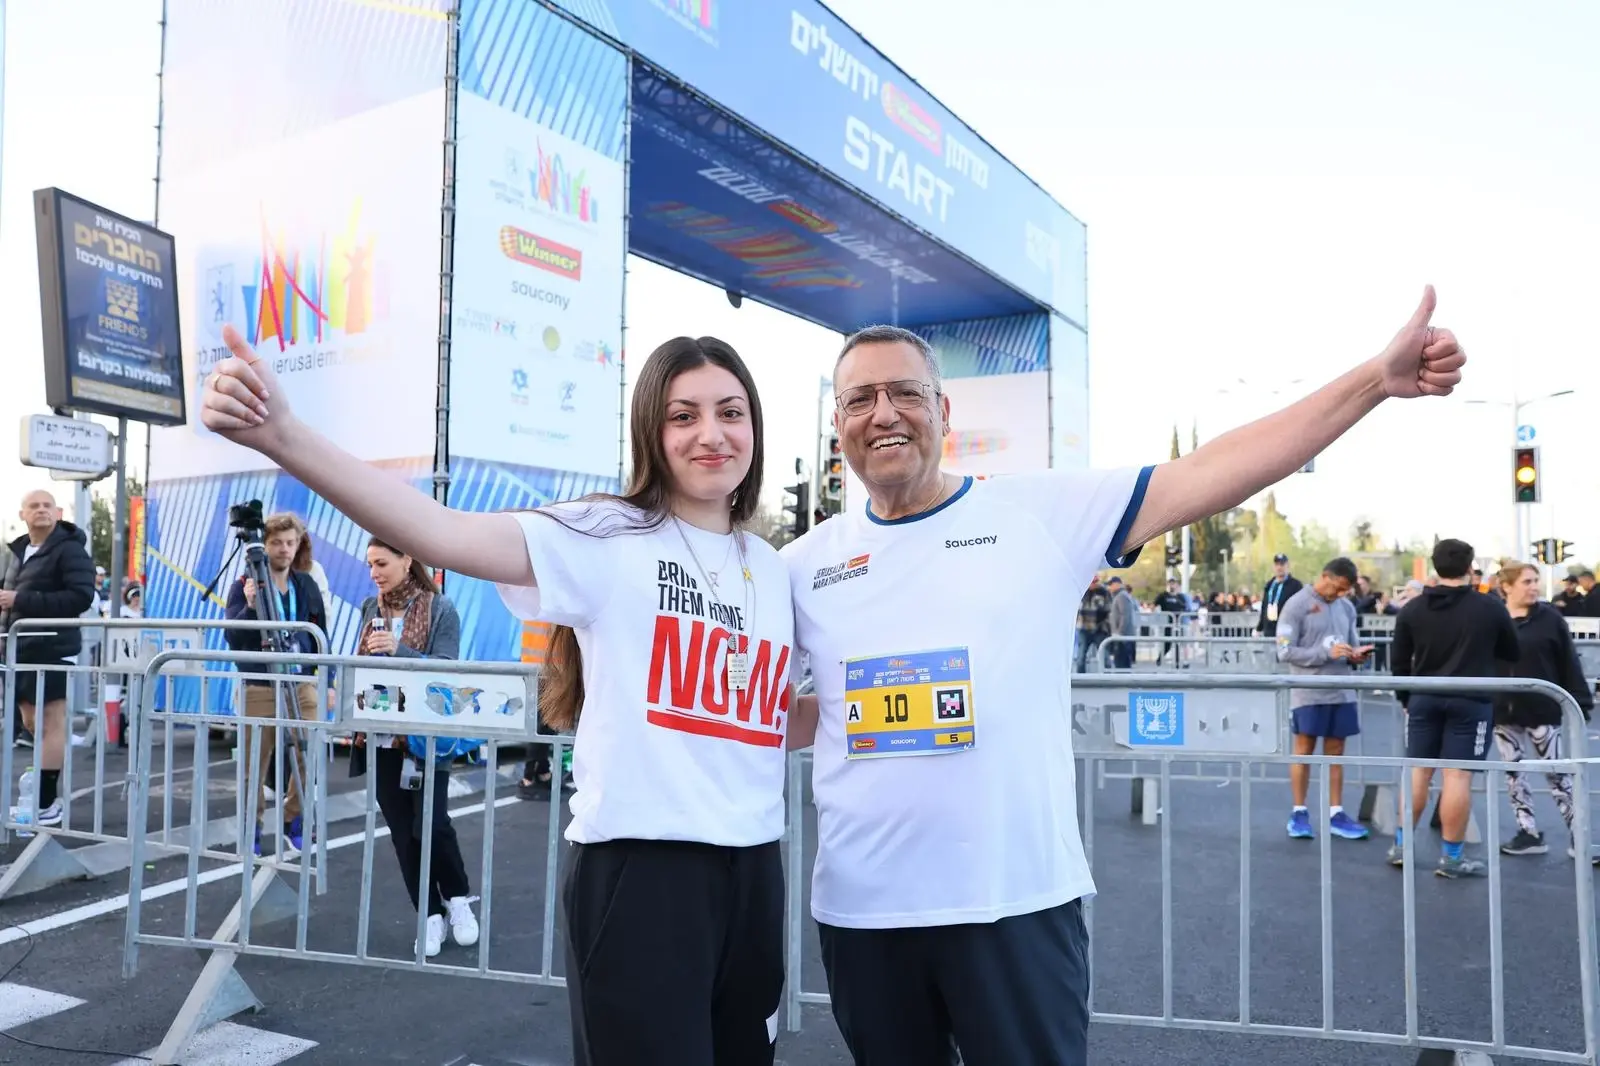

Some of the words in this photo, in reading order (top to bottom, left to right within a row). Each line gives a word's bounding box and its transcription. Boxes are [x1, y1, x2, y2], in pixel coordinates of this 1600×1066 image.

[791, 9, 879, 101] ירושלים
[844, 115, 955, 224] START
[944, 133, 989, 190] מרתון
[74, 221, 161, 273] החברים
[517, 233, 580, 273] Winner
[117, 263, 163, 289] החדשים
[511, 280, 571, 311] saucony
[98, 314, 147, 340] FRIENDS
[945, 535, 997, 549] saucony
[812, 572, 844, 591] MARATHON
[842, 565, 869, 581] 2025
[814, 561, 847, 580] JERUSALEM
[658, 583, 705, 617] THEM
[708, 600, 745, 632] HOME
[848, 704, 860, 721] A
[884, 693, 909, 723] 10
[890, 737, 917, 745] saucony
